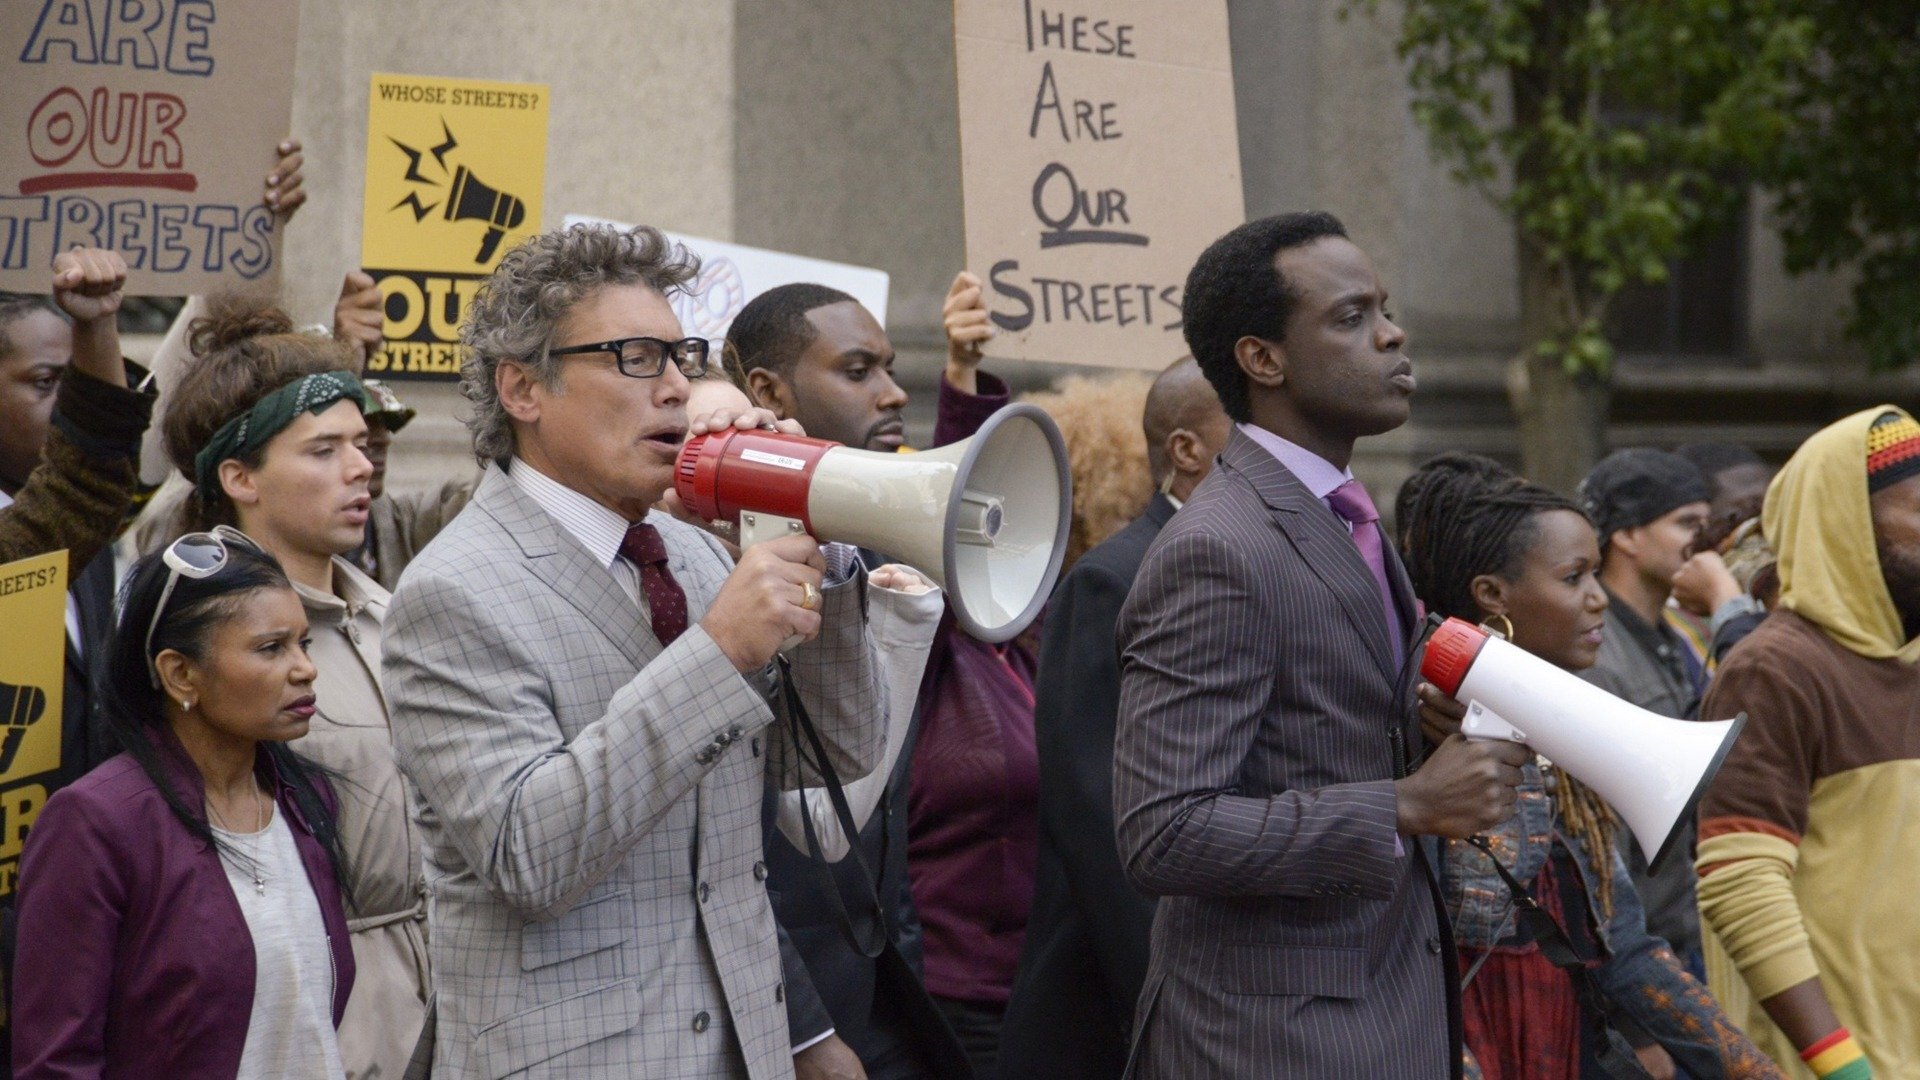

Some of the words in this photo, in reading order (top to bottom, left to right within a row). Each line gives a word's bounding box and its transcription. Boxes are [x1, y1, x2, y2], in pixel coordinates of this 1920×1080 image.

[19, 0, 216, 77] ARE
[27, 86, 187, 169] OUR
[379, 84, 447, 105] WHOSE
[451, 88, 540, 111] STREETS?
[1029, 61, 1123, 143] ARE
[1032, 162, 1130, 230] OUR
